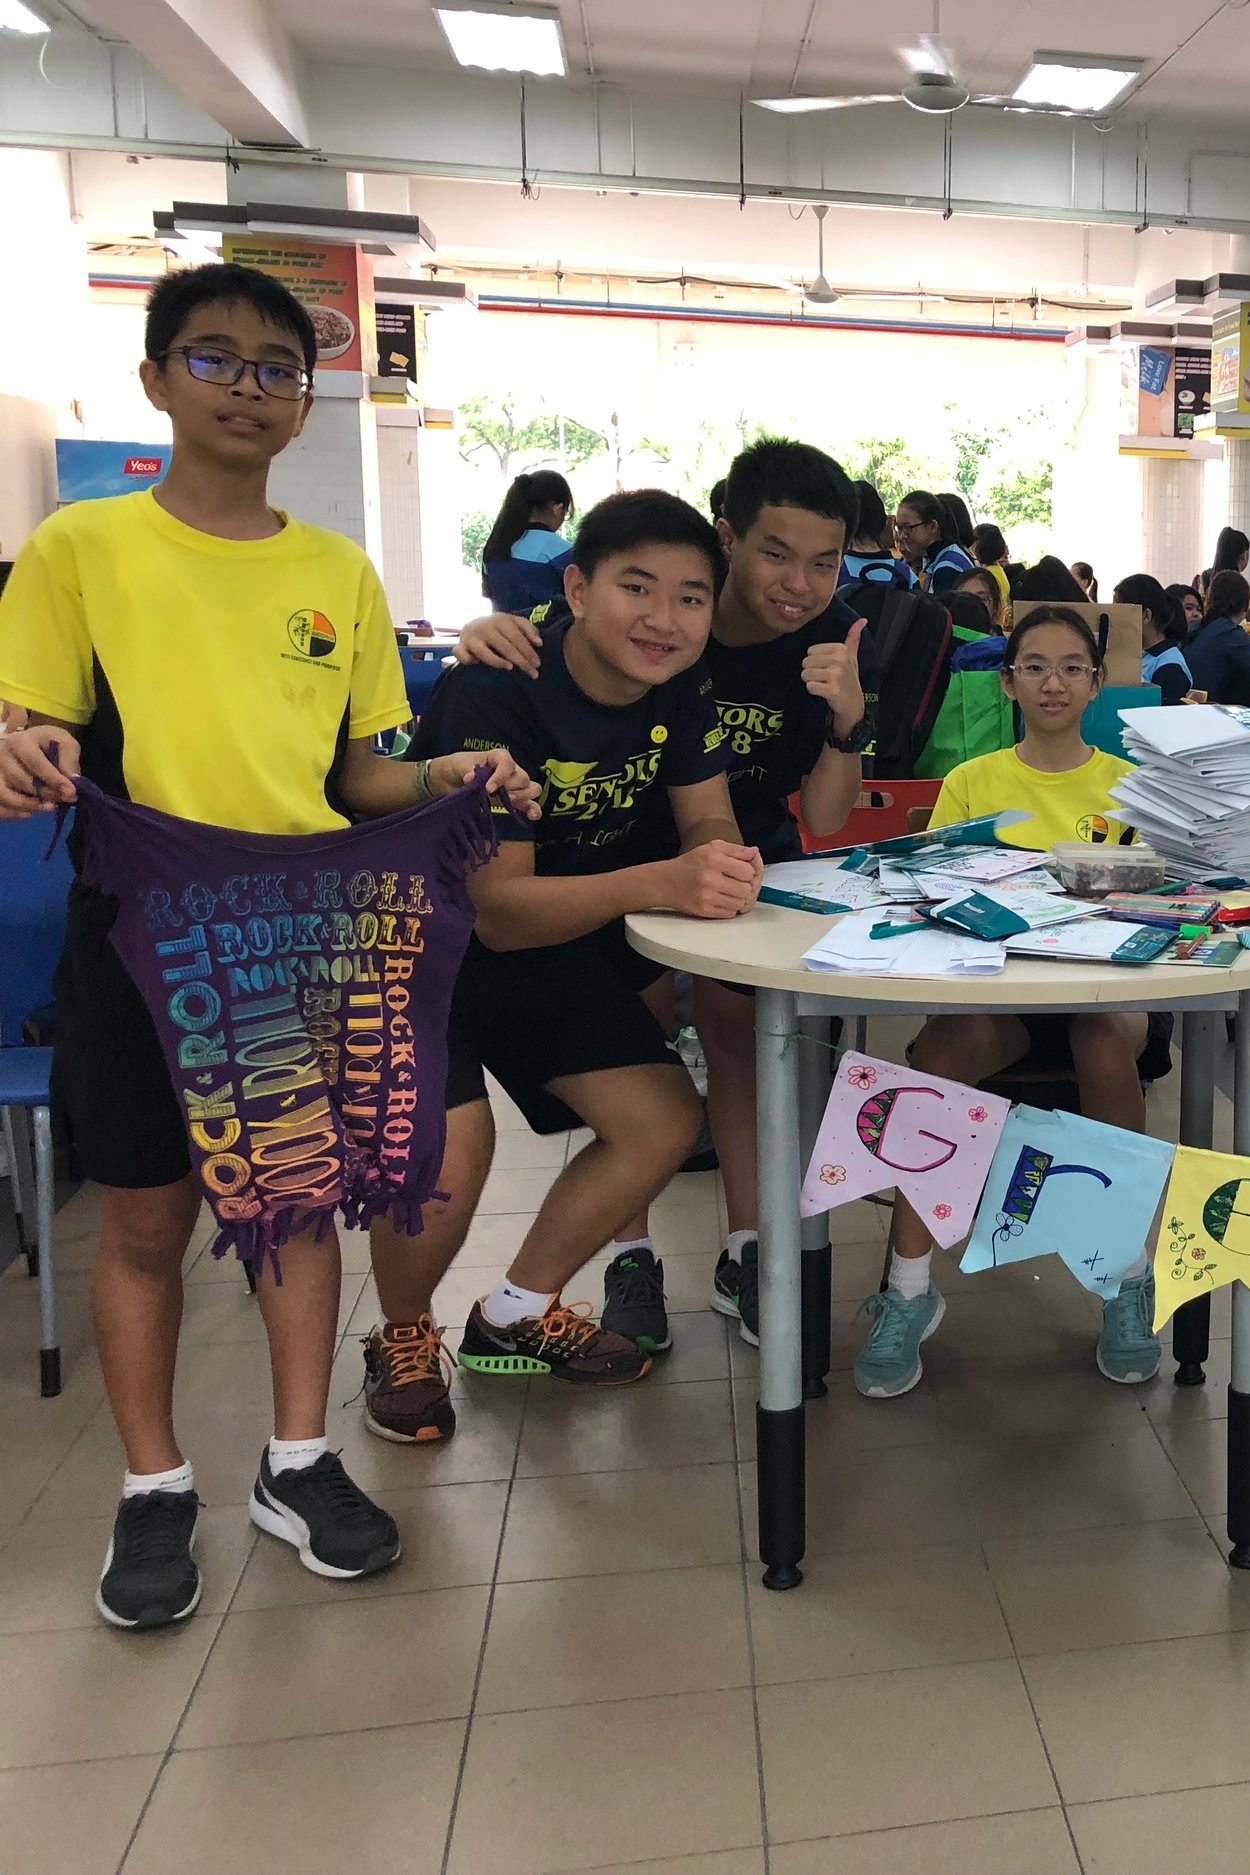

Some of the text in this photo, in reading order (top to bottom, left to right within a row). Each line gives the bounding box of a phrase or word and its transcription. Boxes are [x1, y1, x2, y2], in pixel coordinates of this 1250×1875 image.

[1140, 353, 1154, 385] Milk
[131, 460, 157, 471] Yeo's
[145, 872, 292, 929] ROCK
[311, 869, 434, 914] ROLL
[212, 913, 322, 964] ROCK
[330, 911, 425, 954] ROLL
[155, 924, 229, 1069] ROLL
[229, 992, 326, 1100] ROLL
[344, 981, 384, 1084] ROLL
[385, 955, 416, 1069] ROCK
[189, 1081, 263, 1221] ROCK
[247, 1095, 343, 1208] ROCK
